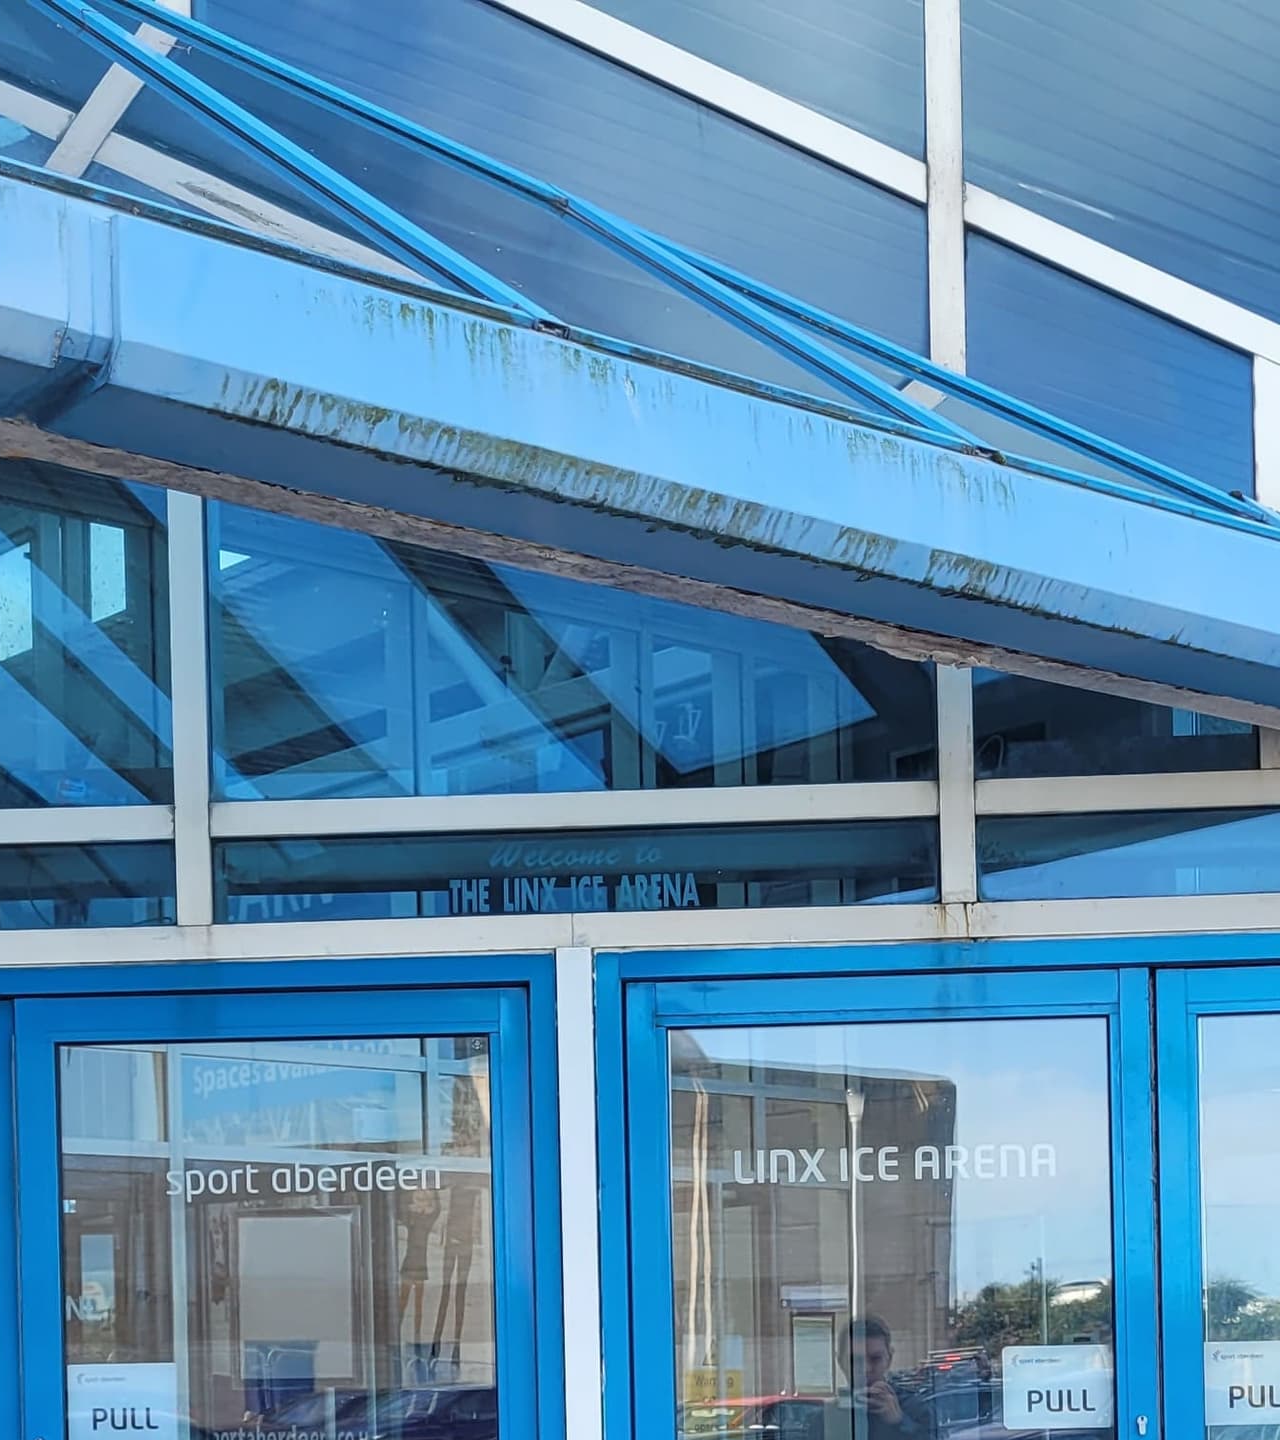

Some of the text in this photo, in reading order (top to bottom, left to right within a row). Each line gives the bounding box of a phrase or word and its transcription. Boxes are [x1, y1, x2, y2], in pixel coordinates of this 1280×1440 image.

[489, 840, 663, 868] Welcome to
[449, 872, 701, 914] THE LINX ICE ARENA
[193, 1061, 259, 1099] Spaces
[165, 1161, 441, 1203] sport aberdeen
[733, 1143, 1057, 1184] LINX ICE ARENA
[91, 1407, 160, 1431] PULL
[1027, 1388, 1096, 1413] PULL
